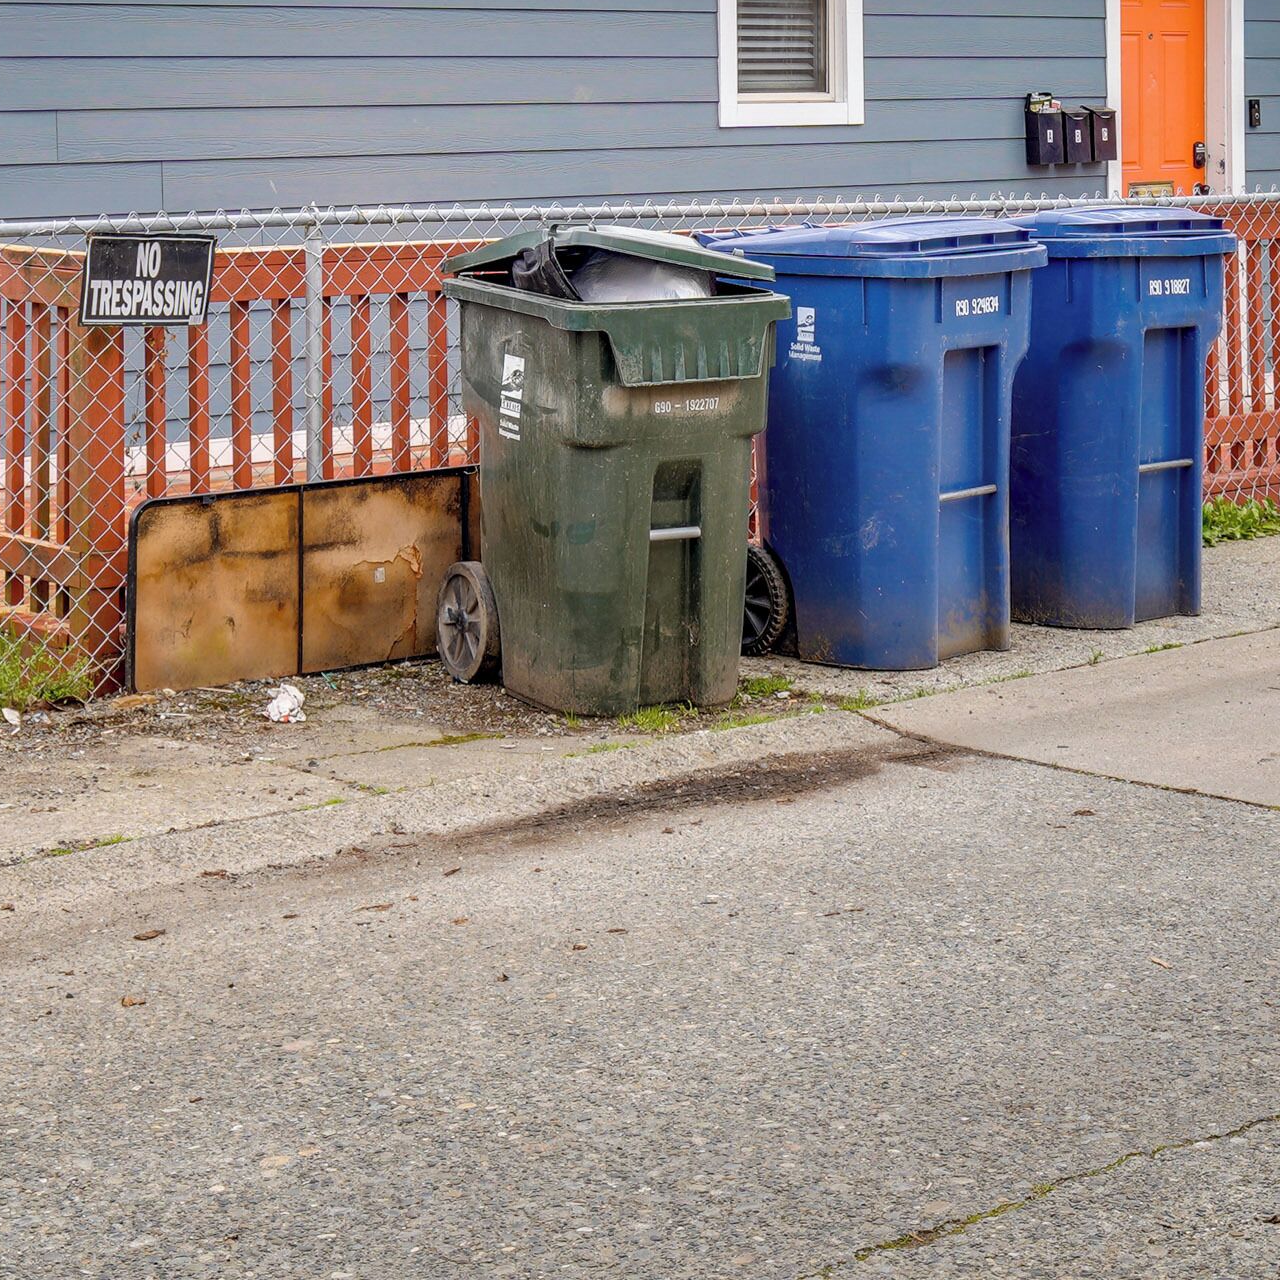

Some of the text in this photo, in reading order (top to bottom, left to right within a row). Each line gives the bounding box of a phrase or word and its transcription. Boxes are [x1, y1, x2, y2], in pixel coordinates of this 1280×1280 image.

[135, 241, 161, 278] NO
[90, 279, 204, 317] TRESPASSING
[955, 295, 999, 317] R90 924834
[788, 349, 822, 361] Management
[790, 342, 821, 353] Solid Waste
[654, 400, 672, 414] G90
[685, 397, 720, 412] 1922707
